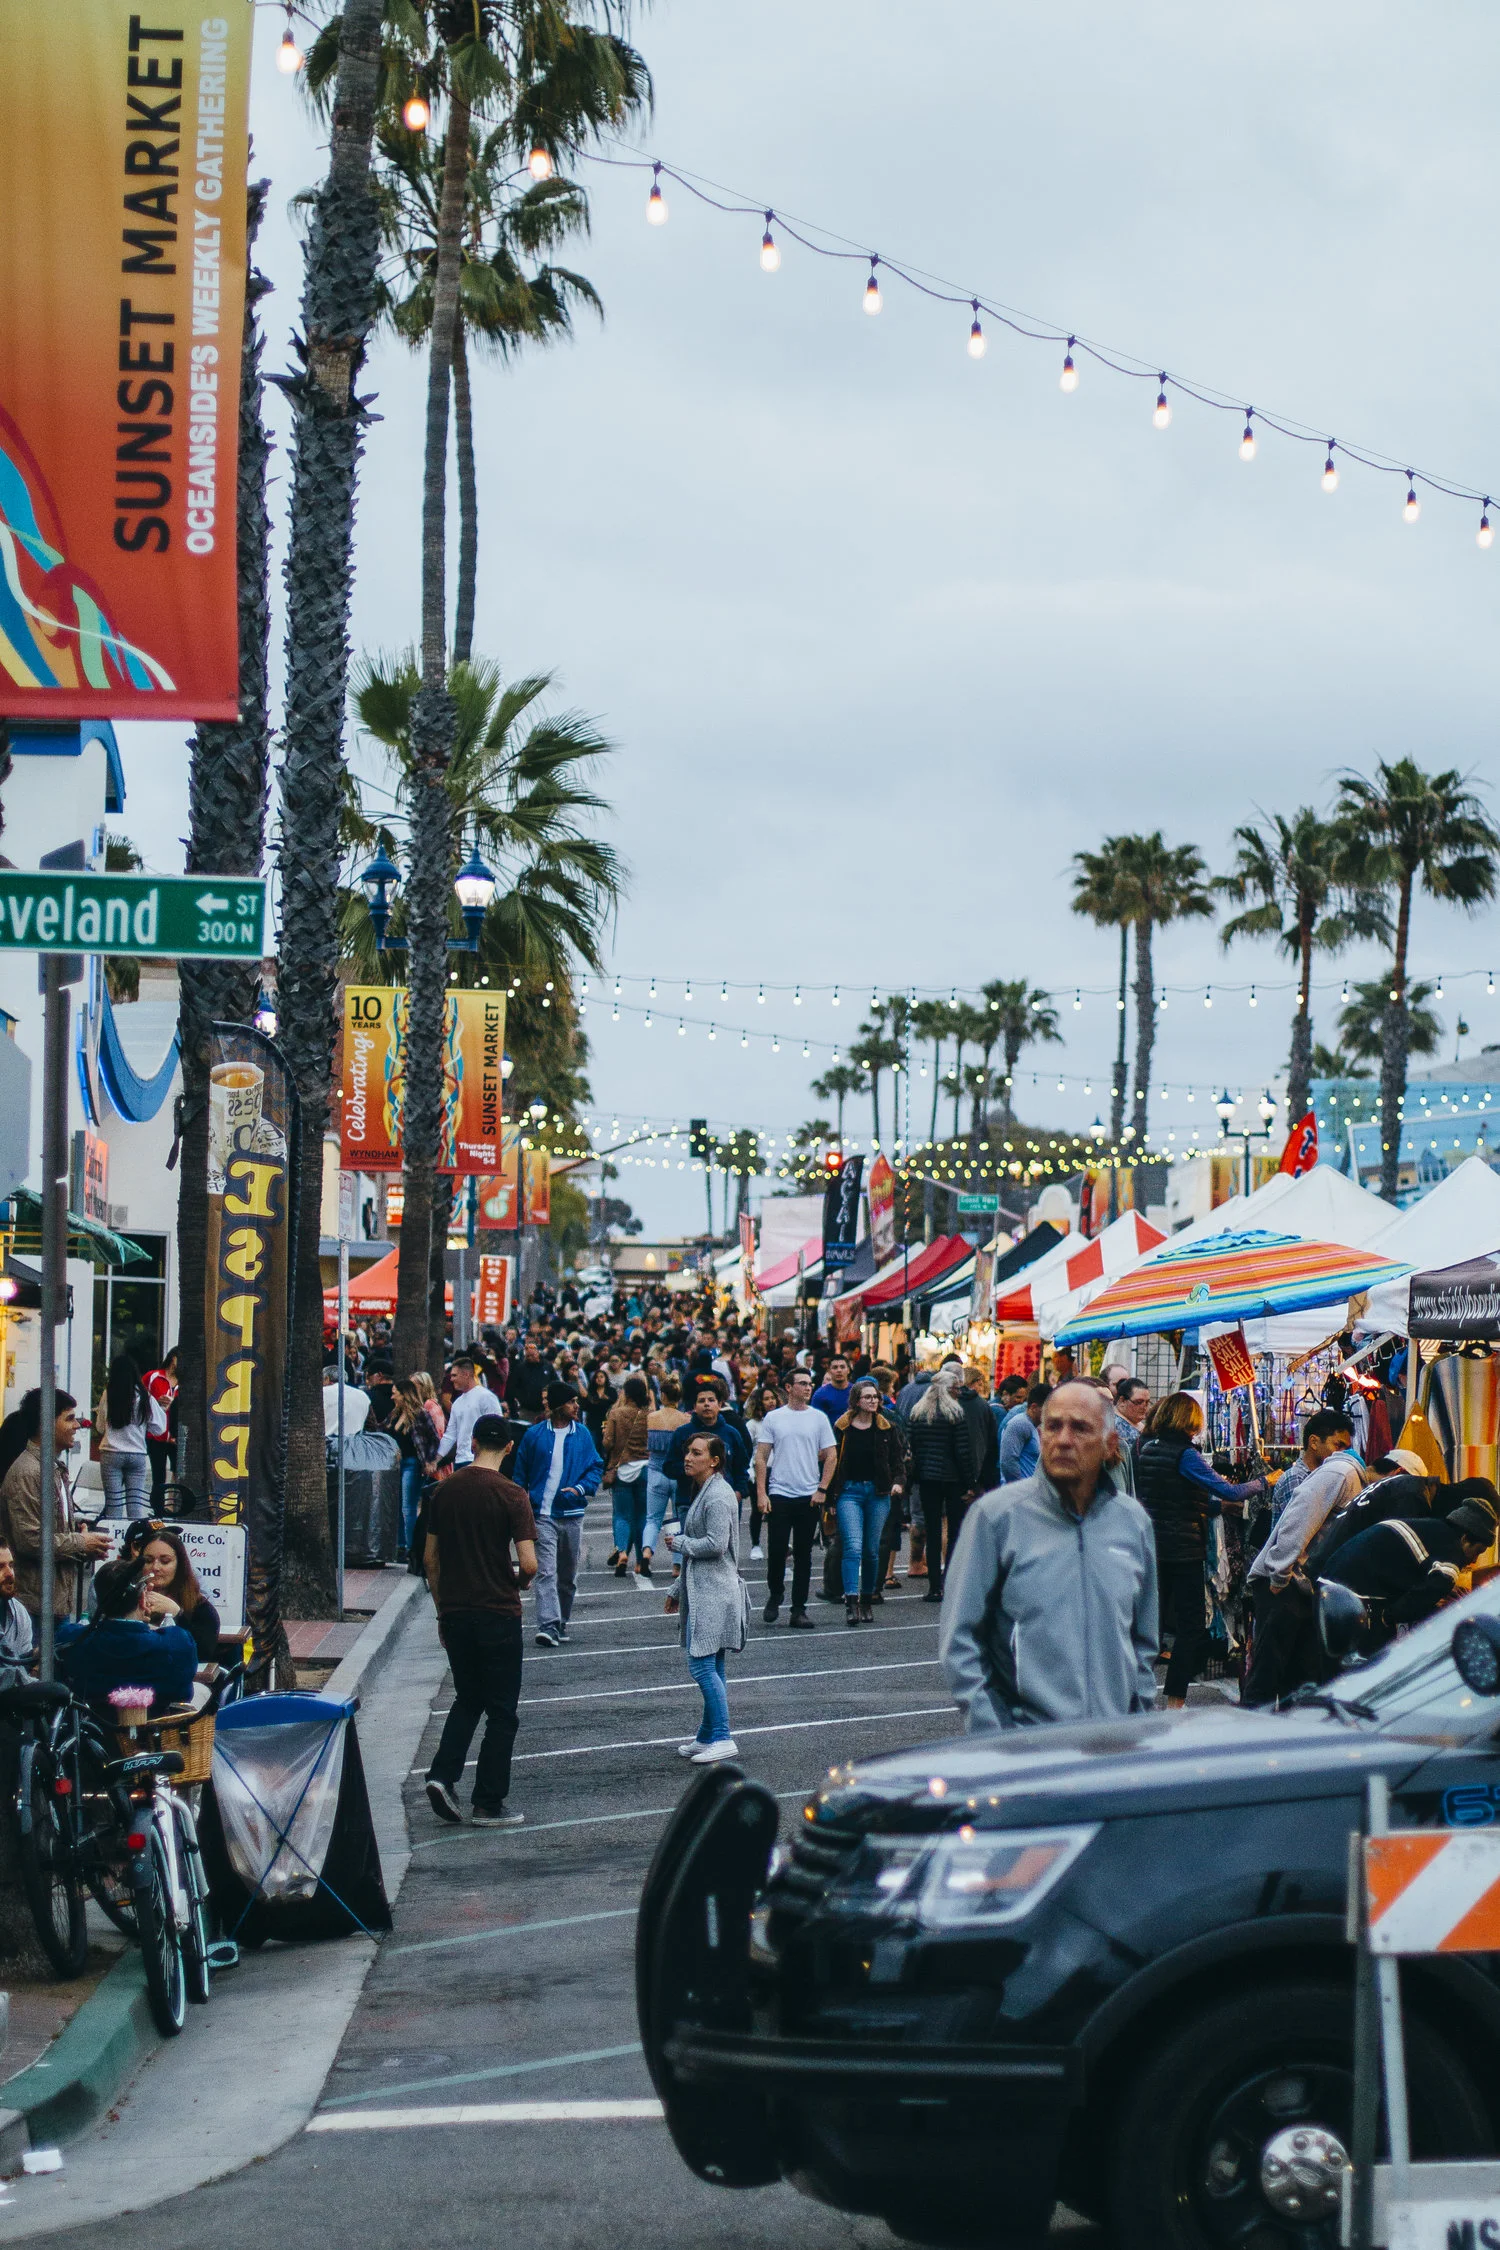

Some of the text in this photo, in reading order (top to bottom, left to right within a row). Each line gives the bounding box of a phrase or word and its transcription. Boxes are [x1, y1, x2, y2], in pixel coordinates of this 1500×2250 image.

[114, 15, 184, 553] SUNSET MARKET
[186, 17, 228, 554] OCEANSIDE'S WEEKLY GATHERING
[0, 885, 158, 945] veland
[237, 895, 259, 916] ST
[198, 921, 254, 943] 300 N
[351, 995, 382, 1021] 10
[352, 1021, 381, 1029] YEARS
[482, 1003, 499, 1135] SUNSET MARKET
[350, 1150, 399, 1158] WYNDHAM
[459, 1142, 496, 1152] Thursday
[470, 1151, 496, 1159] Nights
[487, 1259, 501, 1284] HOT
[1208, 1334, 1231, 1353] SALE
[1216, 1341, 1239, 1365] SALE
[1224, 1352, 1247, 1377] SALE
[1232, 1364, 1254, 1385] SALE
[179, 1532, 204, 1545] ffee
[207, 1535, 225, 1545] Co.
[189, 1548, 206, 1558] Our
[123, 1756, 164, 1771] HUFFY
